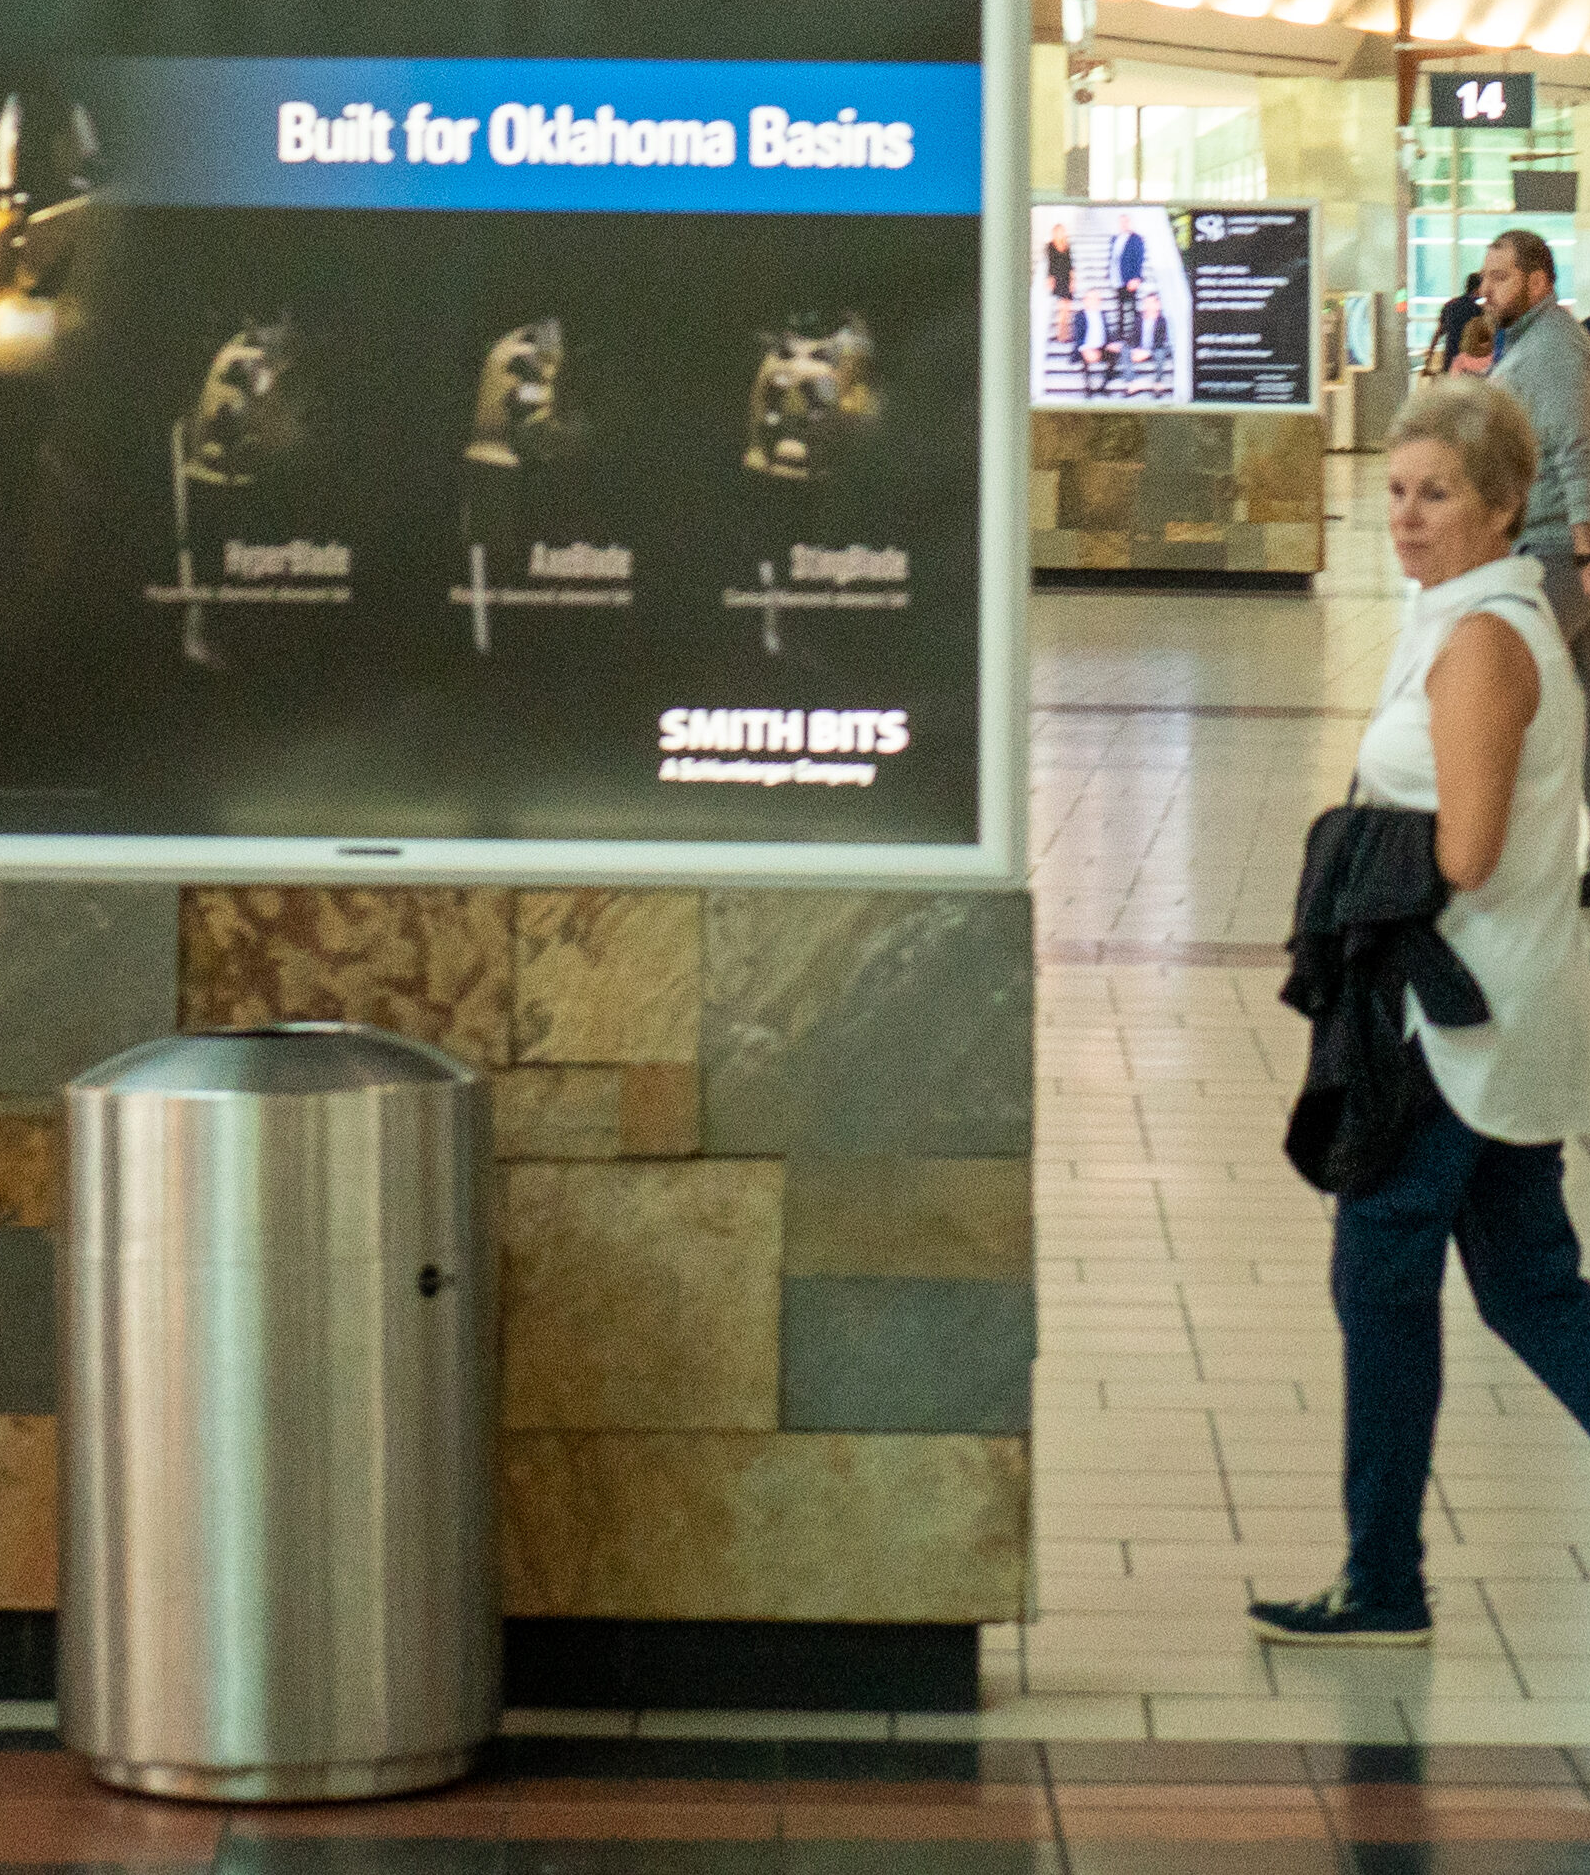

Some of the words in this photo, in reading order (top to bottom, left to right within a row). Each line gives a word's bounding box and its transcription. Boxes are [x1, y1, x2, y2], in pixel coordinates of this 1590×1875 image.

[1455, 80, 1508, 120] 14
[277, 101, 395, 164] Built
[403, 102, 481, 165] for
[488, 101, 737, 168] Oklahoma
[748, 106, 915, 170] Basins
[657, 707, 806, 753] SMITH
[807, 707, 911, 755] BITS
